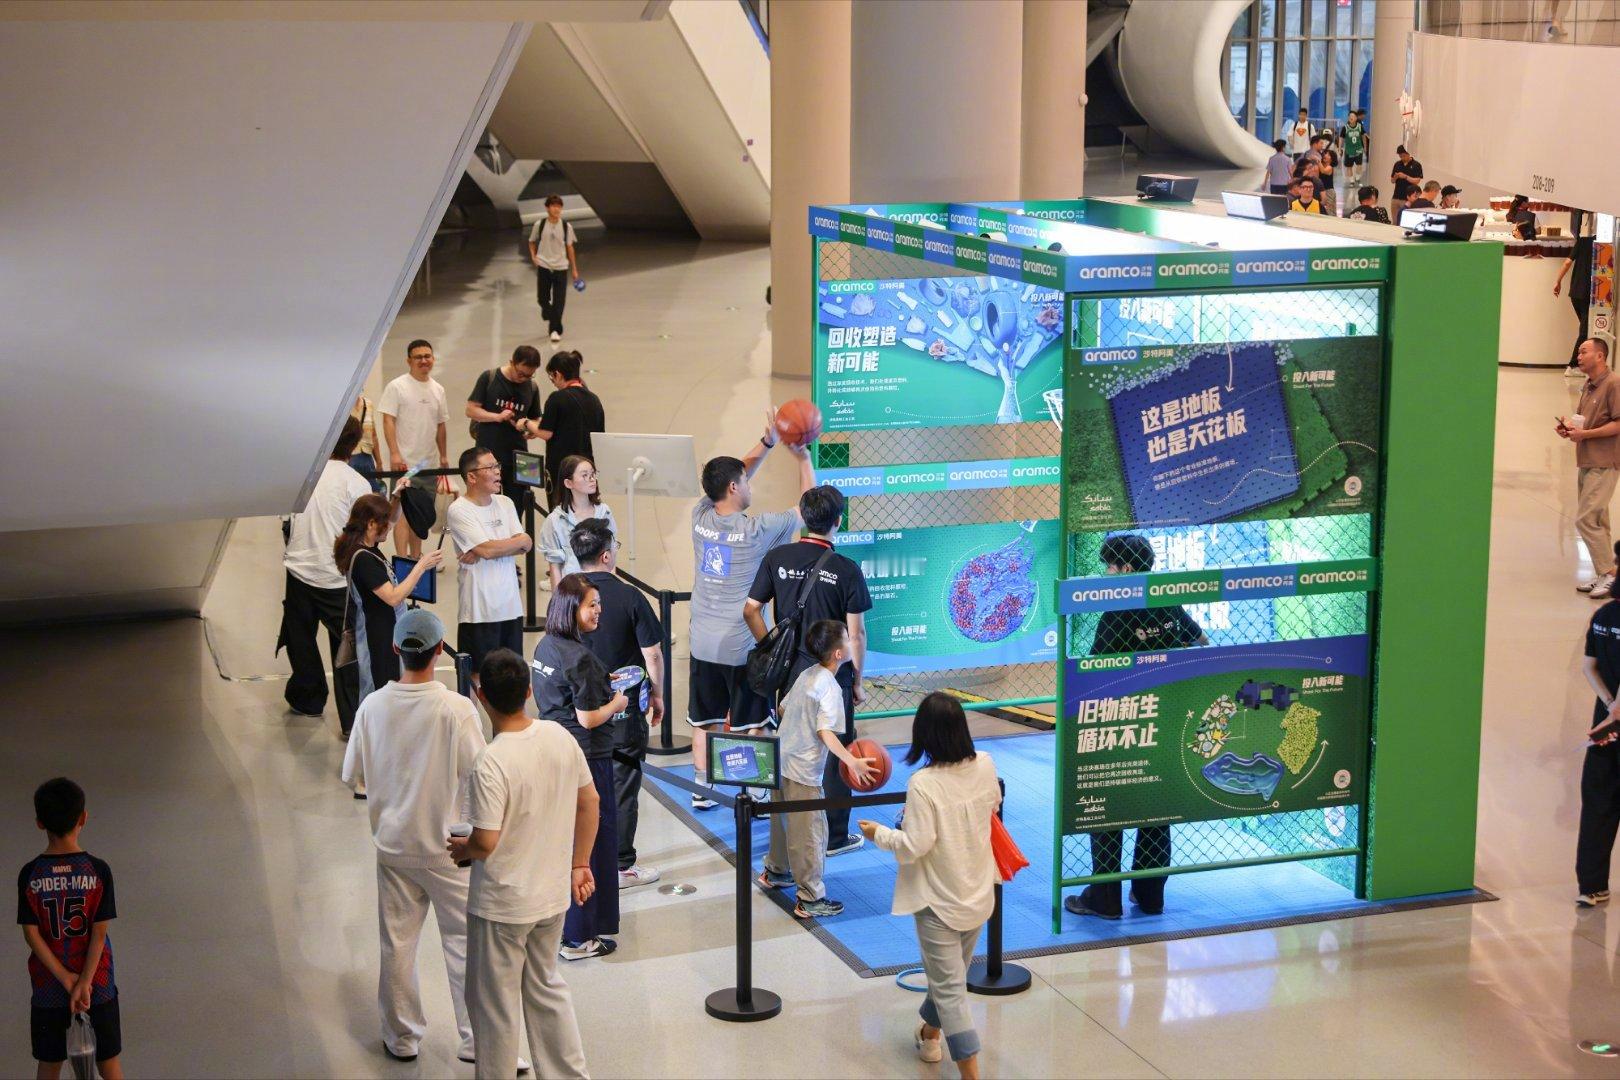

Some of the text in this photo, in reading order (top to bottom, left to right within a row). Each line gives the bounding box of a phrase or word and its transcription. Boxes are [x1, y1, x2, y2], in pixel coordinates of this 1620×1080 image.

[814, 216, 834, 228] aramco
[951, 214, 972, 226] aramco
[979, 219, 1002, 231] aramco
[841, 222, 860, 235] aramco
[867, 228, 889, 242] aramco
[1008, 224, 1032, 236] aramco
[895, 234, 918, 248] aramco
[925, 240, 948, 254] aramco
[956, 246, 981, 260] aramco
[988, 253, 1015, 268] aramco
[1236, 260, 1294, 273] aramco
[1312, 258, 1368, 270] aramco
[1023, 260, 1051, 276] aramco
[1080, 266, 1140, 279] aramco
[1158, 263, 1218, 276] aramco
[831, 282, 874, 292] aramco
[828, 326, 896, 348] 回收塑造
[827, 351, 879, 373] 新可能
[1085, 348, 1173, 362] aramco 沙特阿美
[1141, 386, 1222, 434] 这是地板
[1147, 408, 1247, 463] 也是天花板
[887, 473, 935, 484] aramco
[950, 470, 998, 480] aramco
[1013, 466, 1060, 477] aramco
[727, 533, 744, 541] LIFE
[1226, 576, 1282, 590] aramco
[1300, 570, 1356, 584] aramco
[1072, 587, 1132, 602] aramco
[1150, 582, 1208, 596] aramco
[1080, 654, 1168, 670] aramco 沙特阿美
[1078, 694, 1159, 724] 旧物新生
[1077, 722, 1158, 753] 循环不止
[30, 876, 96, 894] SPIDER-MAN
[43, 896, 88, 939] 15
